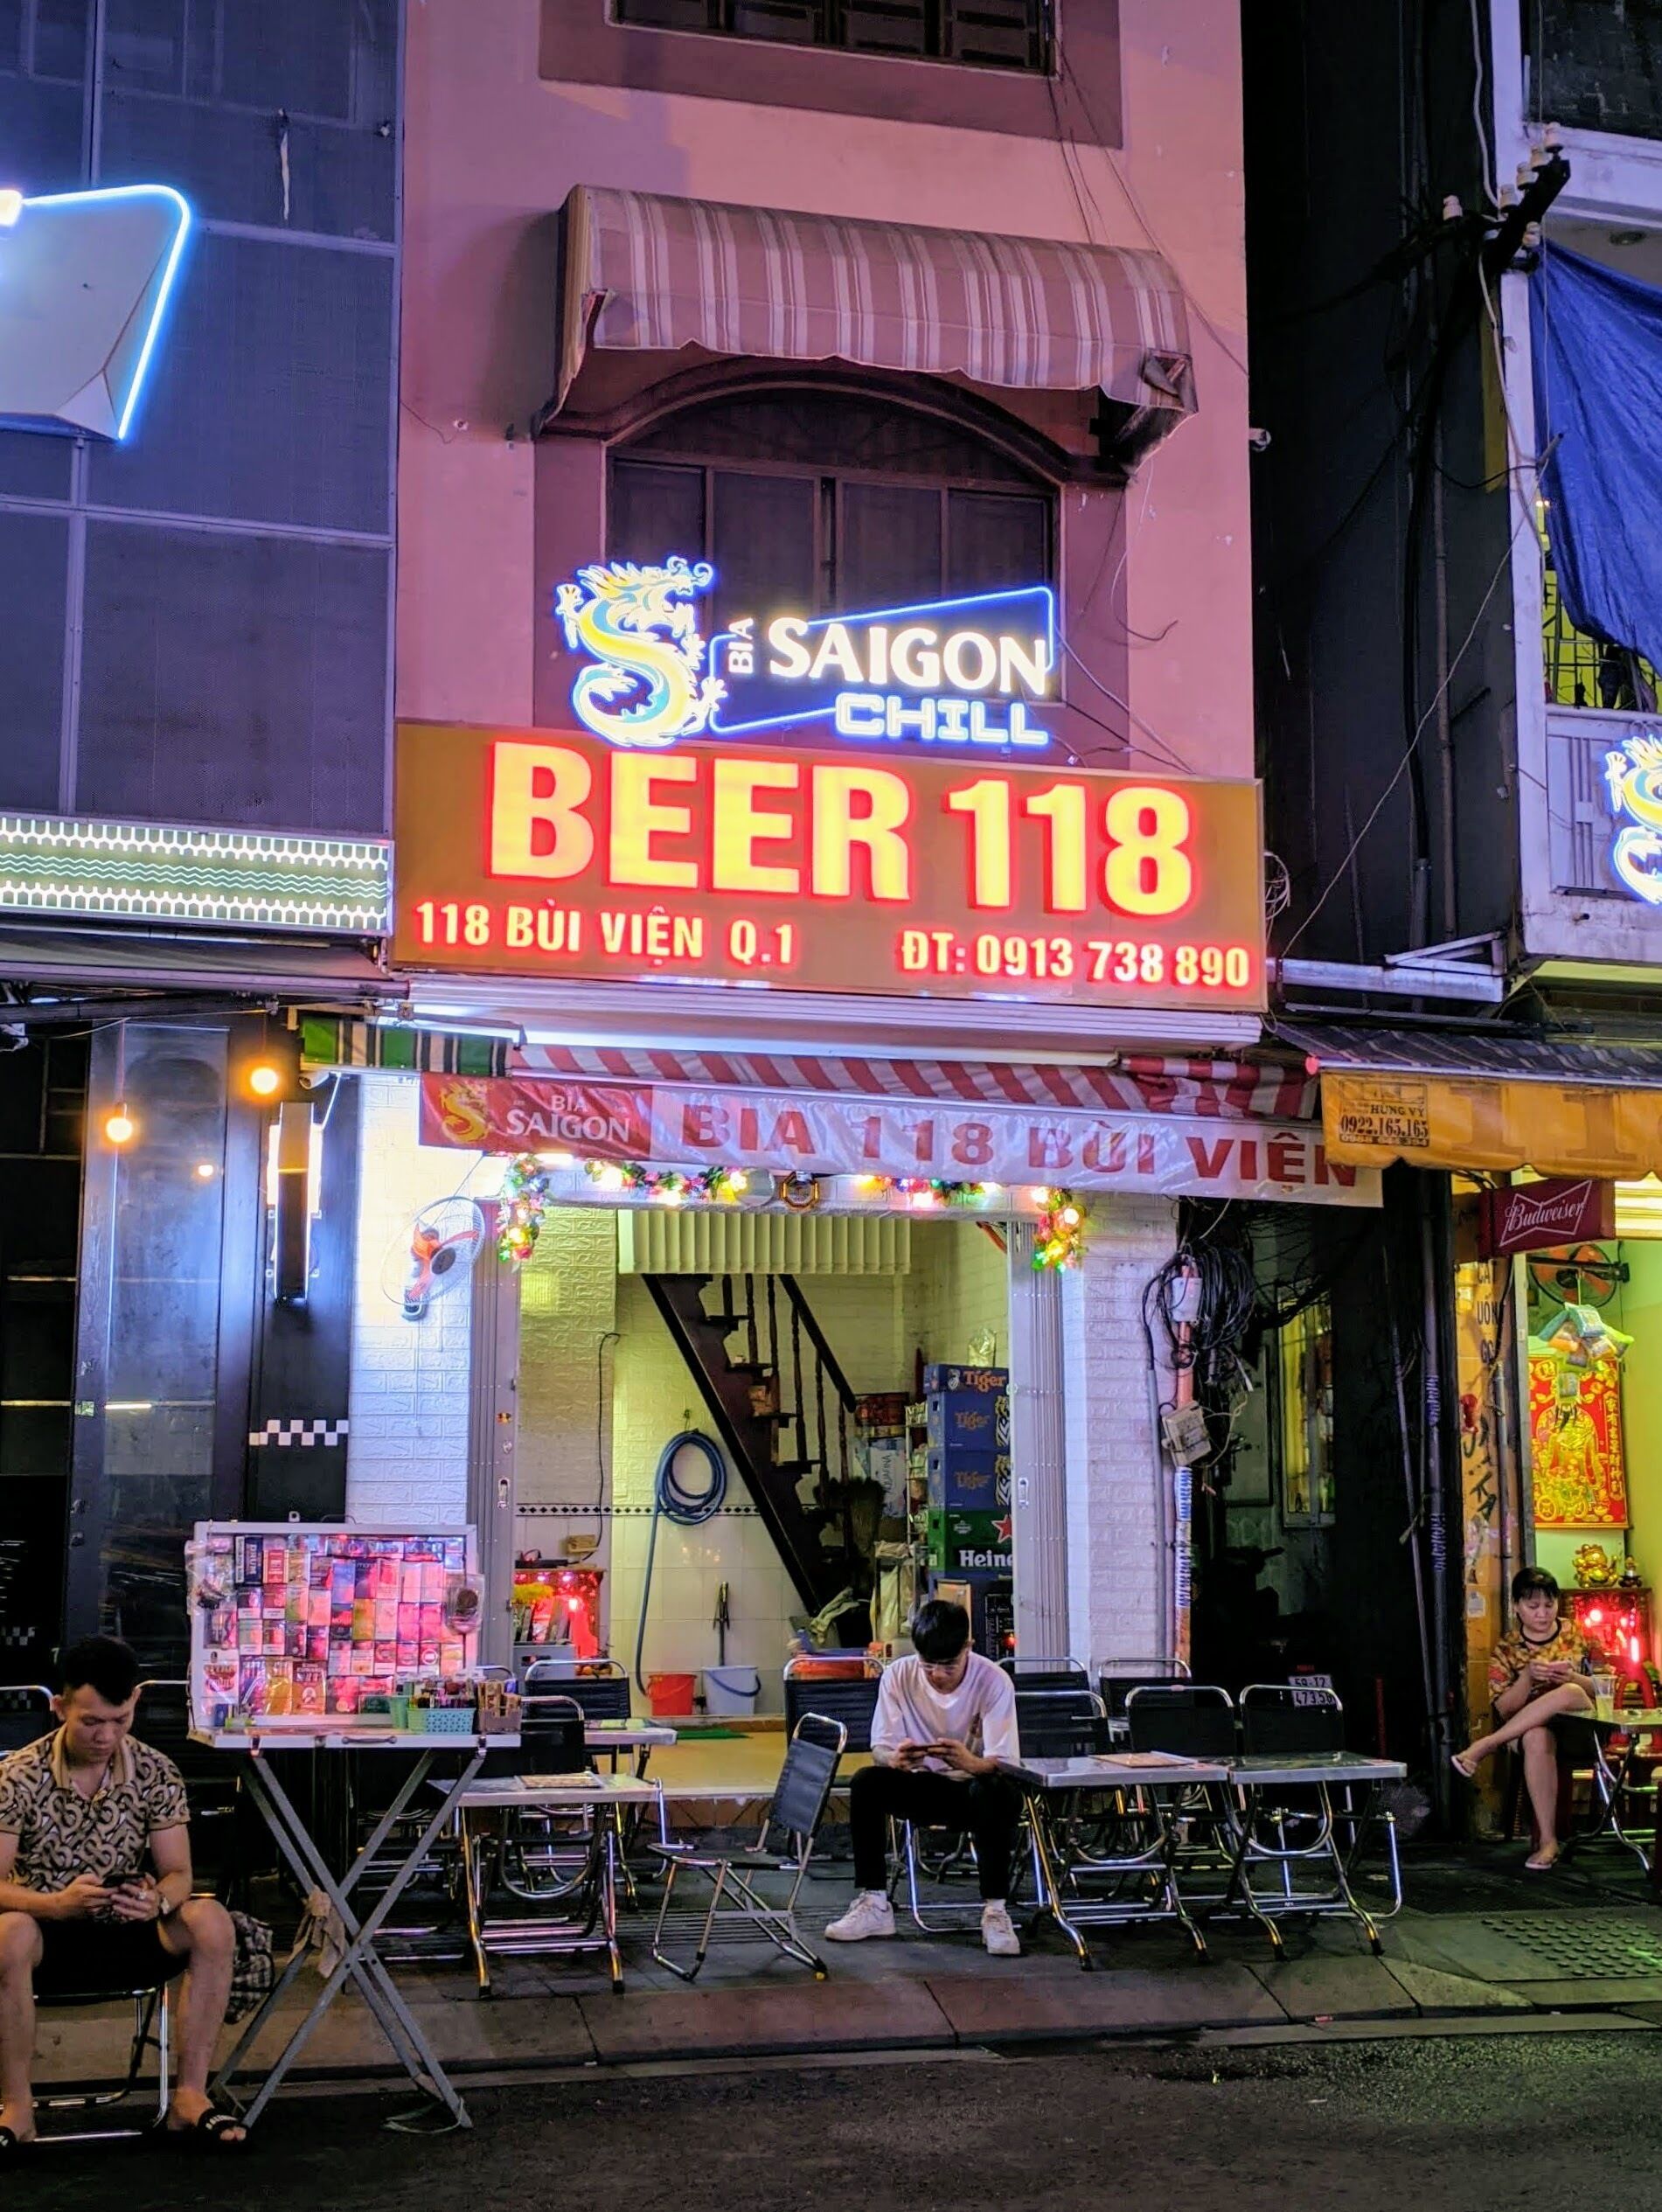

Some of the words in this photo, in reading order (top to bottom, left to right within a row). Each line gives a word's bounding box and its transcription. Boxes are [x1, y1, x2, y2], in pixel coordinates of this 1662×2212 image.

[728, 618, 754, 674] BIA
[768, 617, 1046, 695] SAIGON
[836, 692, 1048, 745] CHILL
[490, 741, 910, 901] BEER
[948, 779, 1193, 915] 118
[416, 901, 490, 945] 118
[506, 898, 581, 952] BÙI
[600, 906, 703, 965] VIỆN
[729, 919, 792, 965] Q.1
[901, 929, 966, 972] ĐT:
[976, 934, 1074, 978] 0913
[1088, 941, 1164, 984] 738
[1176, 945, 1249, 987] 890
[551, 1095, 588, 1113] BIA
[1340, 1115, 1429, 1137] 0922.165.165
[506, 1109, 630, 1144] SAIGON
[682, 1103, 817, 1155] BIA
[851, 1115, 995, 1166] 118
[1029, 1119, 1157, 1175] BÙI
[1504, 1199, 1585, 1232] Budweiser
[963, 1369, 1006, 1392] Tiger
[955, 1409, 990, 1431] Tiger
[955, 1470, 992, 1490] Tiger
